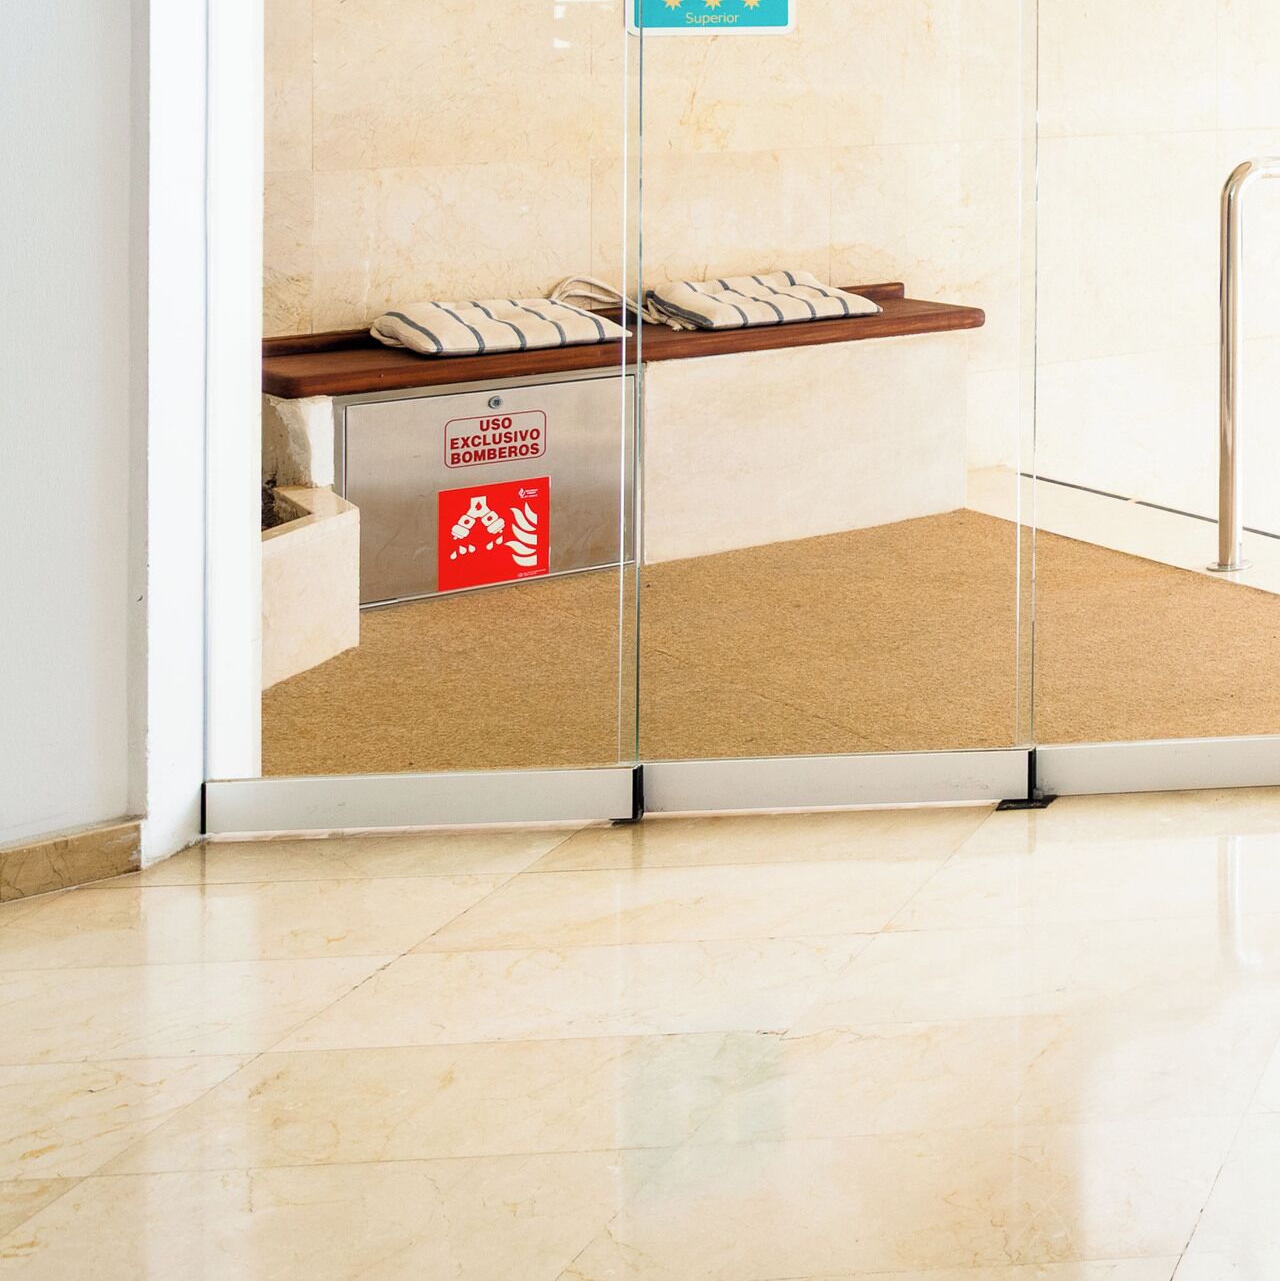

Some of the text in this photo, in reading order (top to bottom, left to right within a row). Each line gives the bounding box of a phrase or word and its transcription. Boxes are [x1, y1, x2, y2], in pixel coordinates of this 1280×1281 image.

[685, 11, 740, 26] Superior
[479, 417, 513, 432] USO
[450, 428, 541, 450] EXCLUSIVO
[450, 443, 540, 466] BOMBEROS
